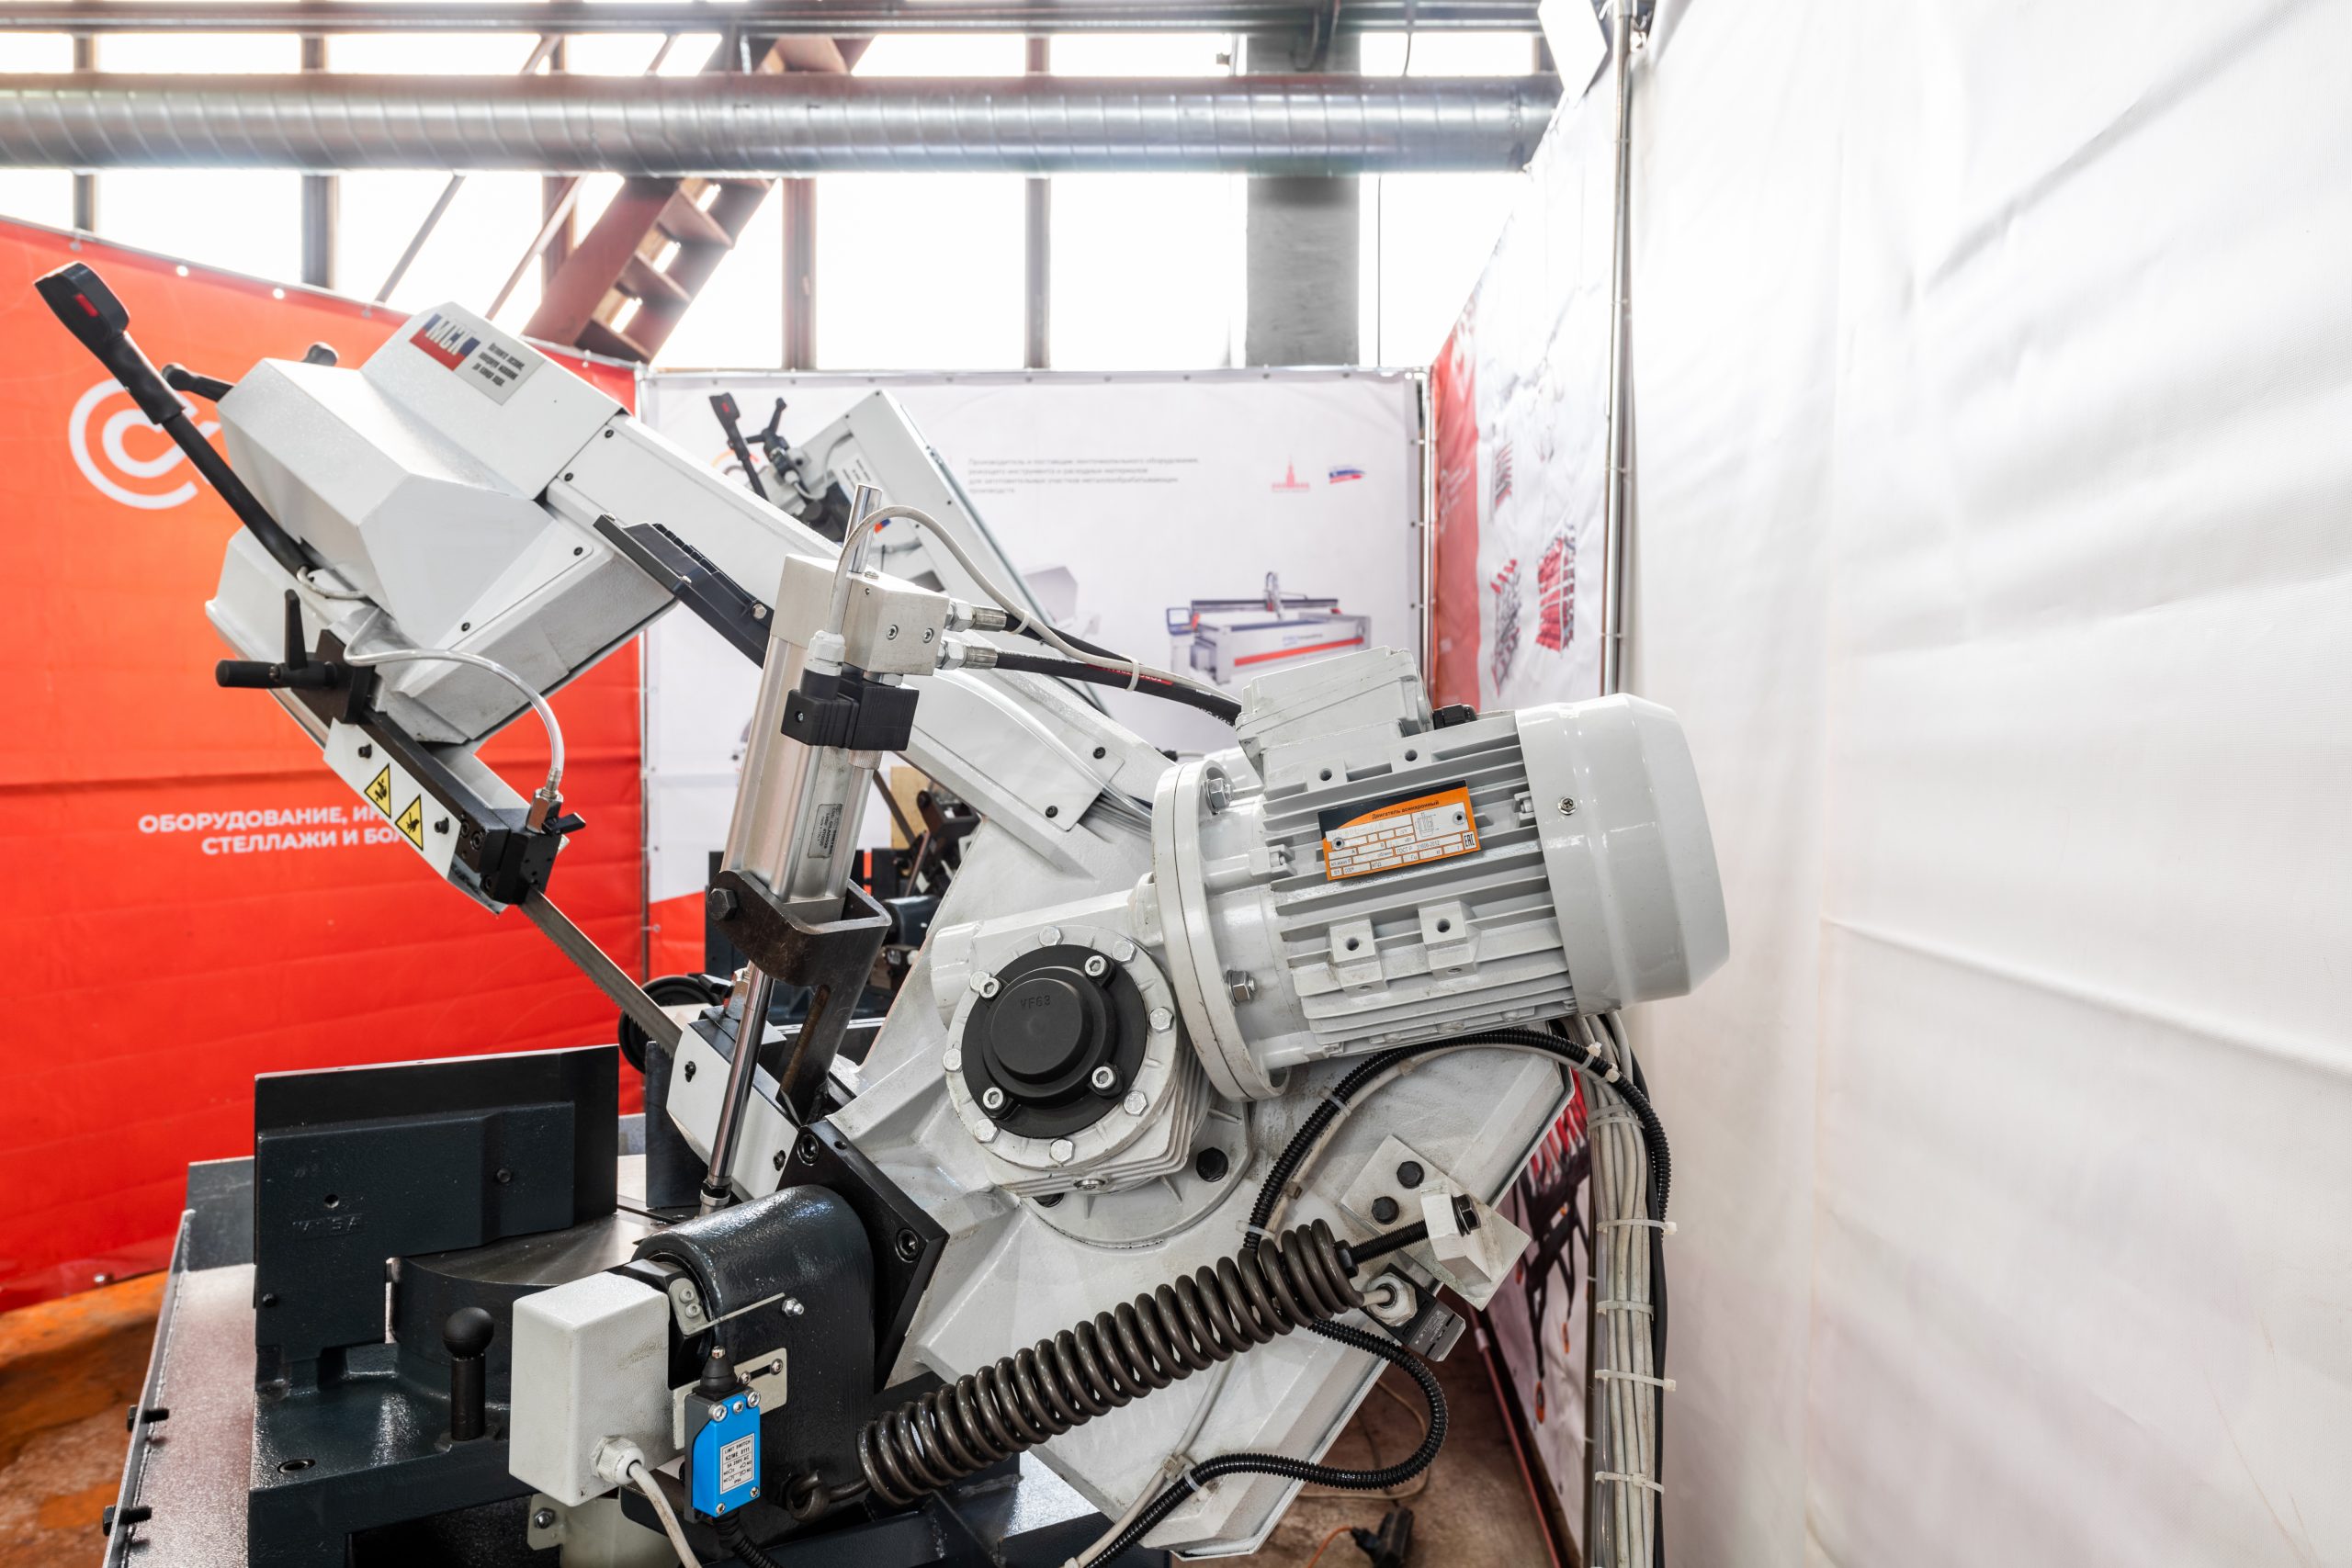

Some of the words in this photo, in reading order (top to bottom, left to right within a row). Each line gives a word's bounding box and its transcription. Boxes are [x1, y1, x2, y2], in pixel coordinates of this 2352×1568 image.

[138, 806, 347, 834] ОБОРУДОВАНИЕ,
[1372, 809, 1401, 819] Двигатель
[201, 830, 336, 855] СТЕЛЛАЖИ
[343, 829, 358, 846] И
